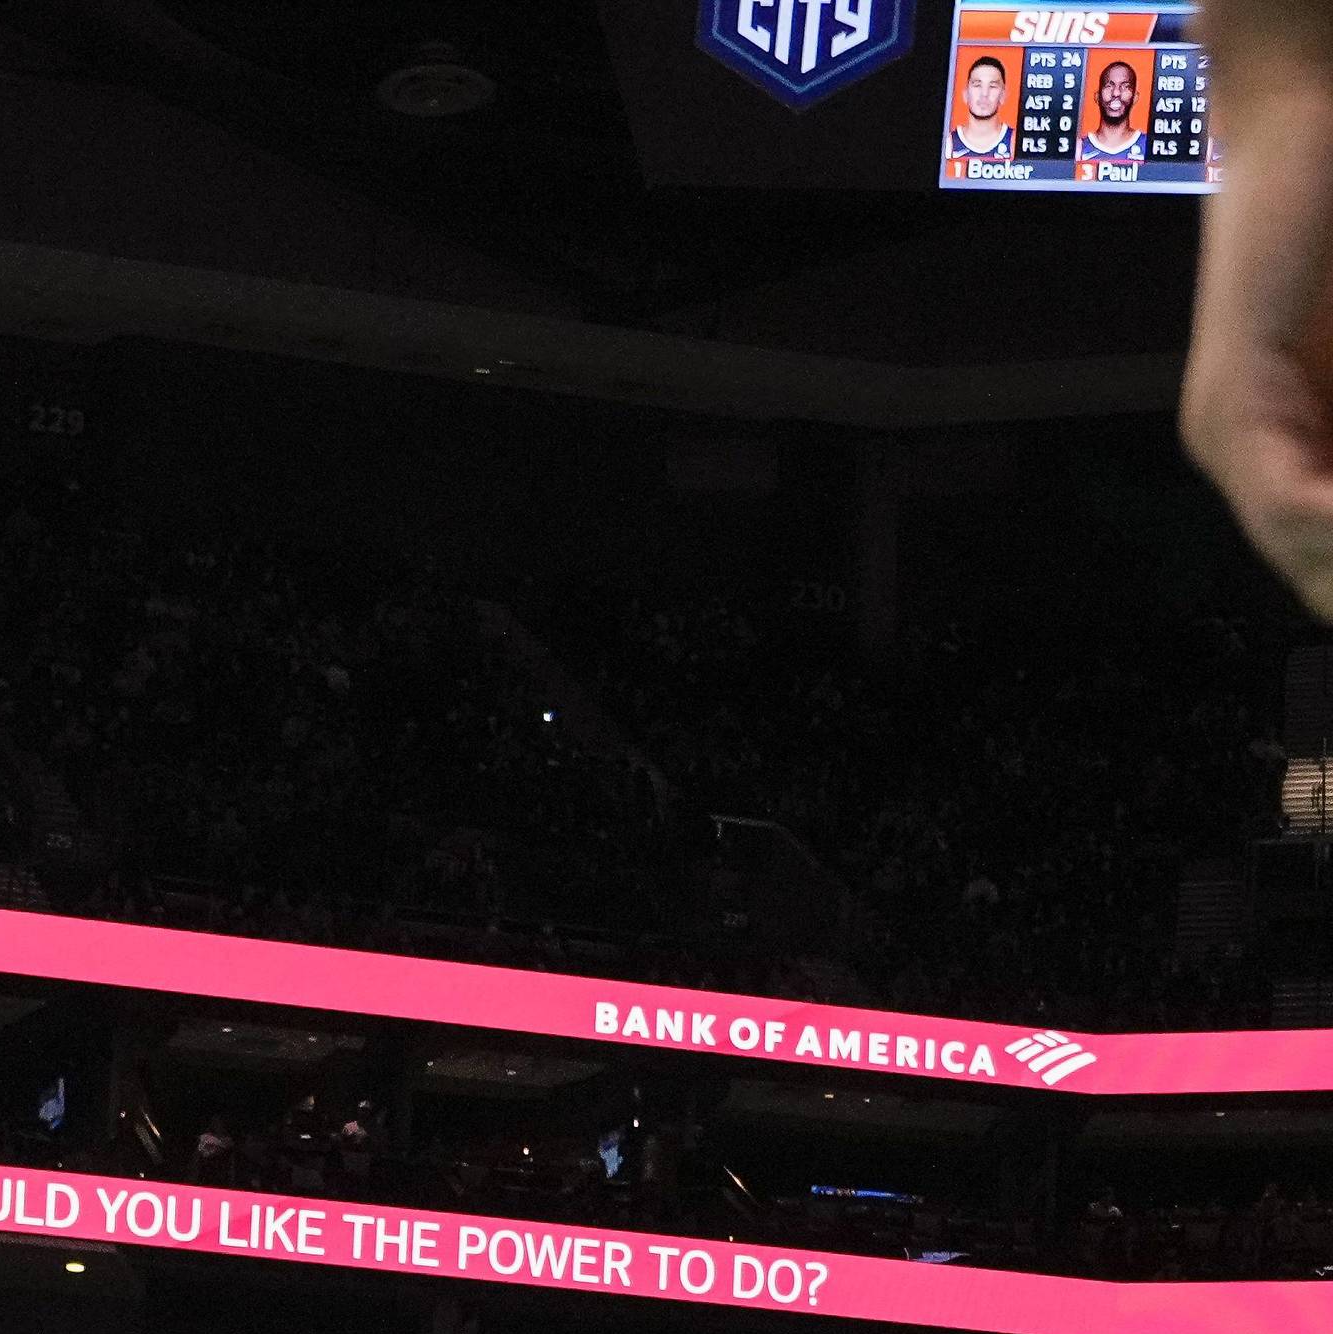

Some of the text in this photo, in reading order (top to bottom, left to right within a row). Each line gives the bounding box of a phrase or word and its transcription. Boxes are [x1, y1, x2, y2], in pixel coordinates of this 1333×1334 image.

[1030, 53, 1081, 68] PTS 24
[1161, 55, 1187, 70] PTS
[1027, 74, 1075, 90] REB 5
[1158, 77, 1206, 91] REB 5
[1025, 95, 1073, 111] AST 2
[1156, 97, 1206, 113] AST 12
[1023, 116, 1071, 132] BLK 0
[1154, 118, 1202, 134] BLK 0
[1022, 138, 1069, 153] FLS 3
[1152, 140, 1200, 155] FLS 2
[967, 161, 1034, 180] Booker
[1082, 163, 1139, 182] 3 Paul
[596, 1002, 995, 1076] BANK OF AMERICA
[97, 1189, 201, 1241] YOU
[220, 1201, 325, 1255] LIKE
[343, 1215, 439, 1266] THE
[459, 1226, 632, 1286] POWER
[649, 1246, 714, 1294] TO
[733, 1255, 827, 1306] DO?
